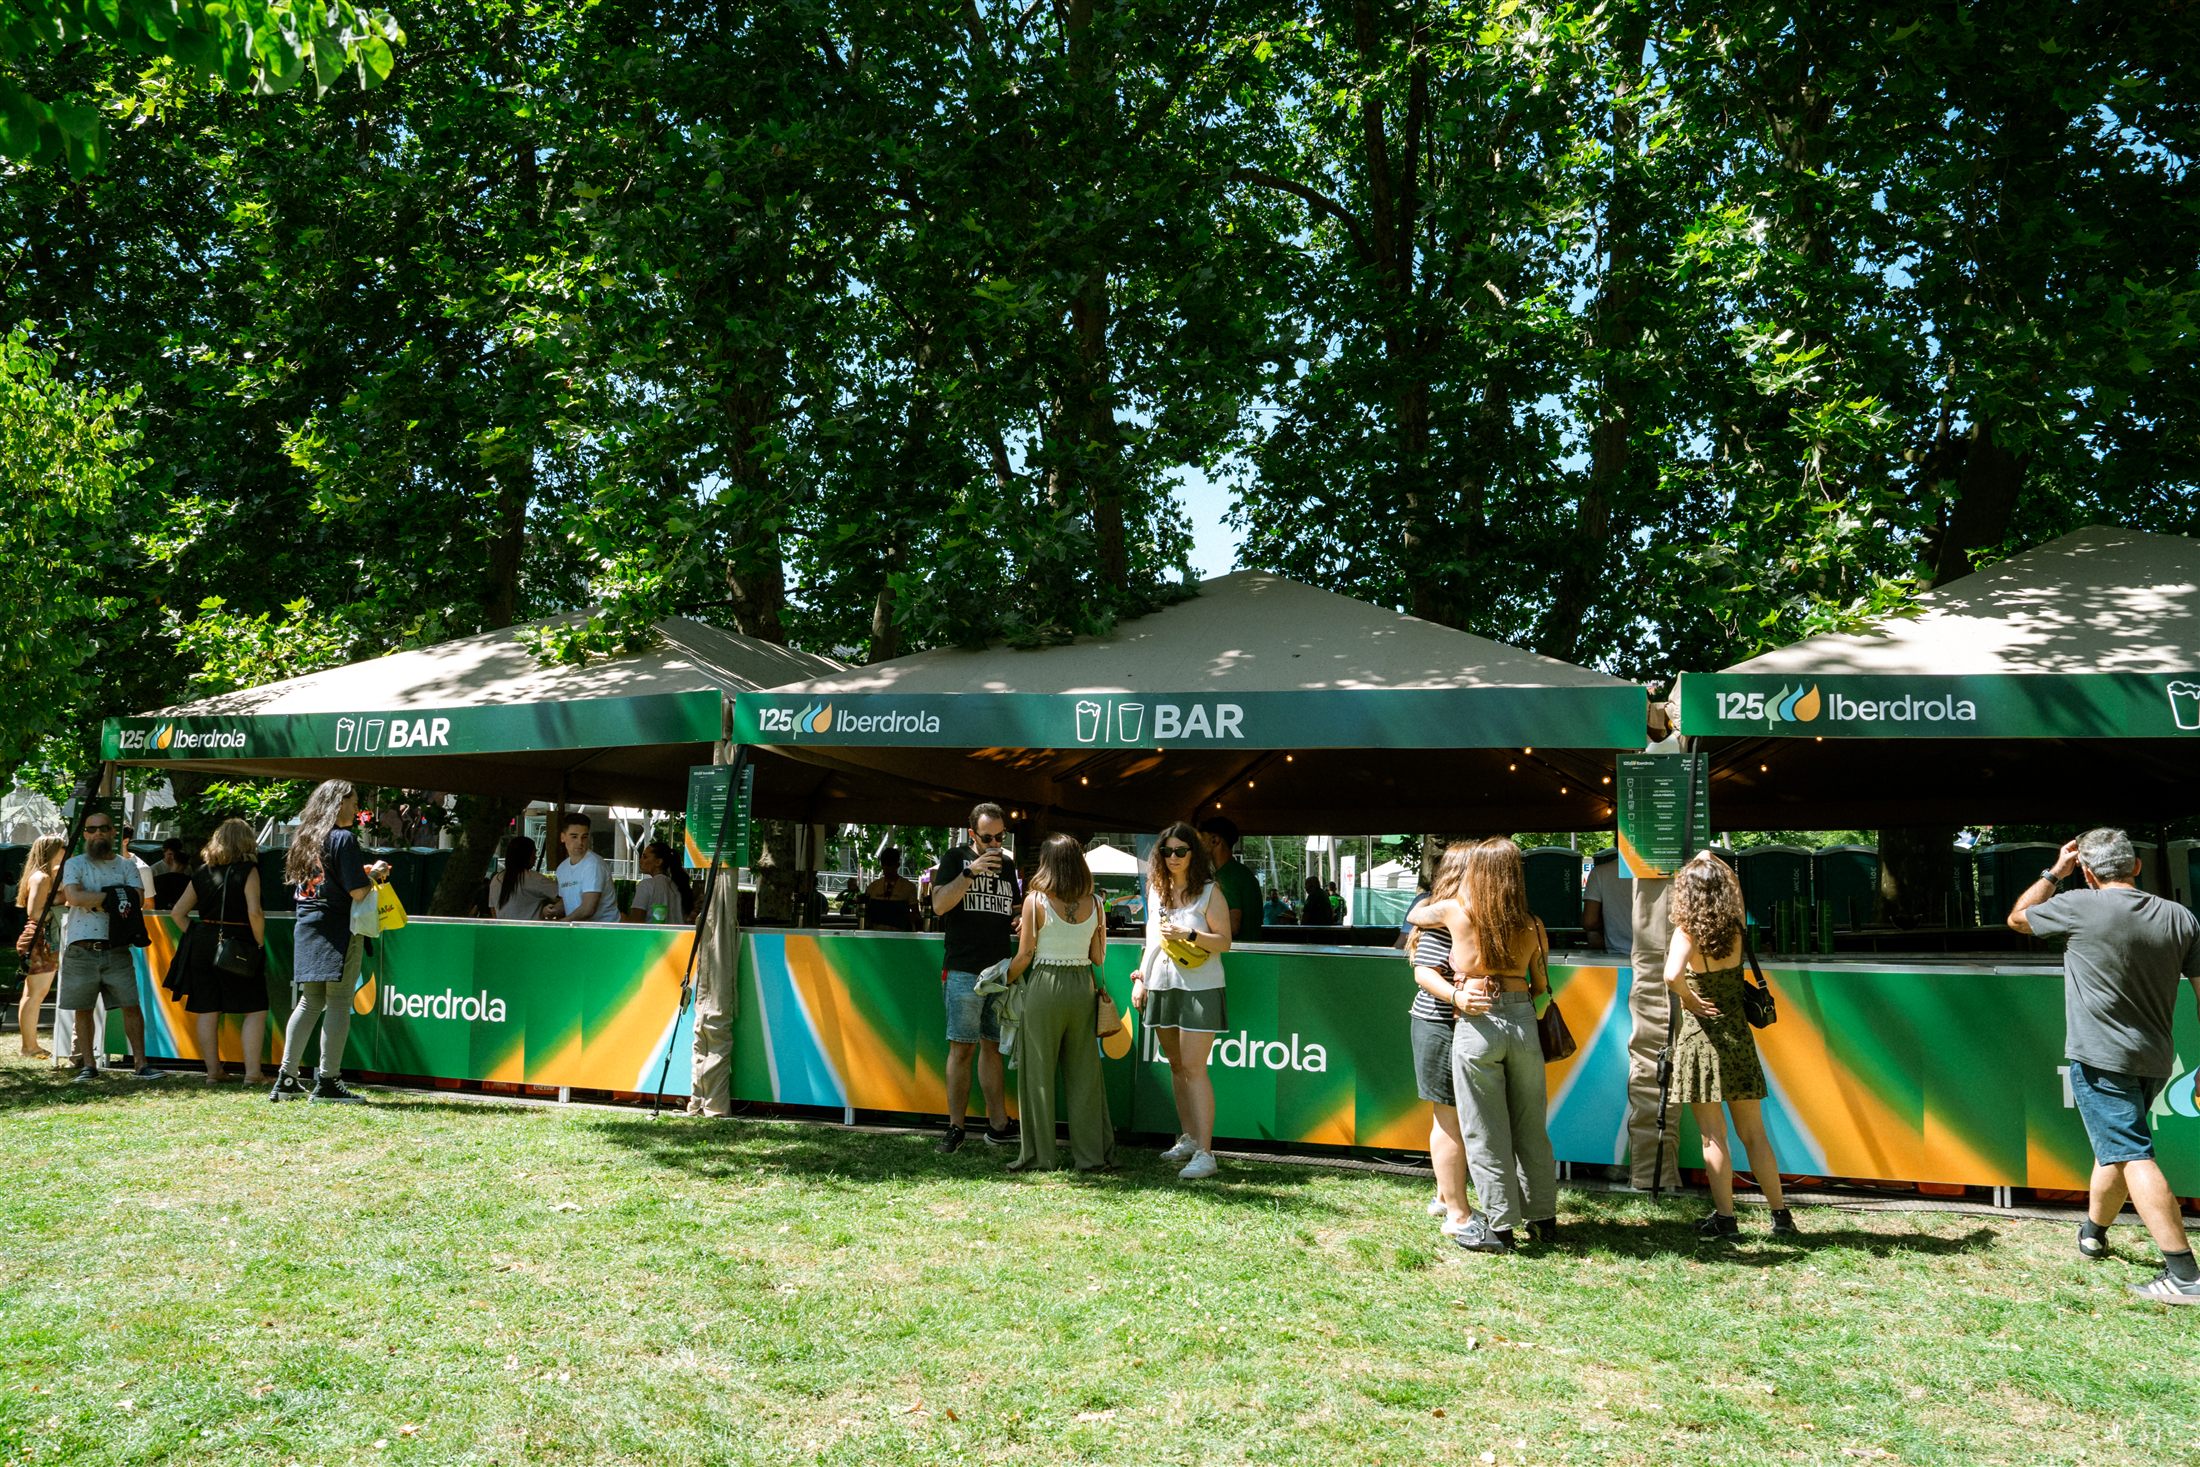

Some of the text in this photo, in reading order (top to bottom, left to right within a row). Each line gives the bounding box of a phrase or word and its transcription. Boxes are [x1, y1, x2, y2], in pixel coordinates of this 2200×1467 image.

[1153, 704, 1245, 738] BAR
[1716, 692, 1977, 721] 125 Iberdrola
[388, 718, 450, 748] BAR
[760, 708, 941, 735] 125 Iberdrola
[119, 729, 246, 749] 125 Iberdrola
[968, 876, 993, 893] OVE
[383, 985, 507, 1023] Iberdrola
[1143, 1026, 1327, 1072] Ibrdrola
